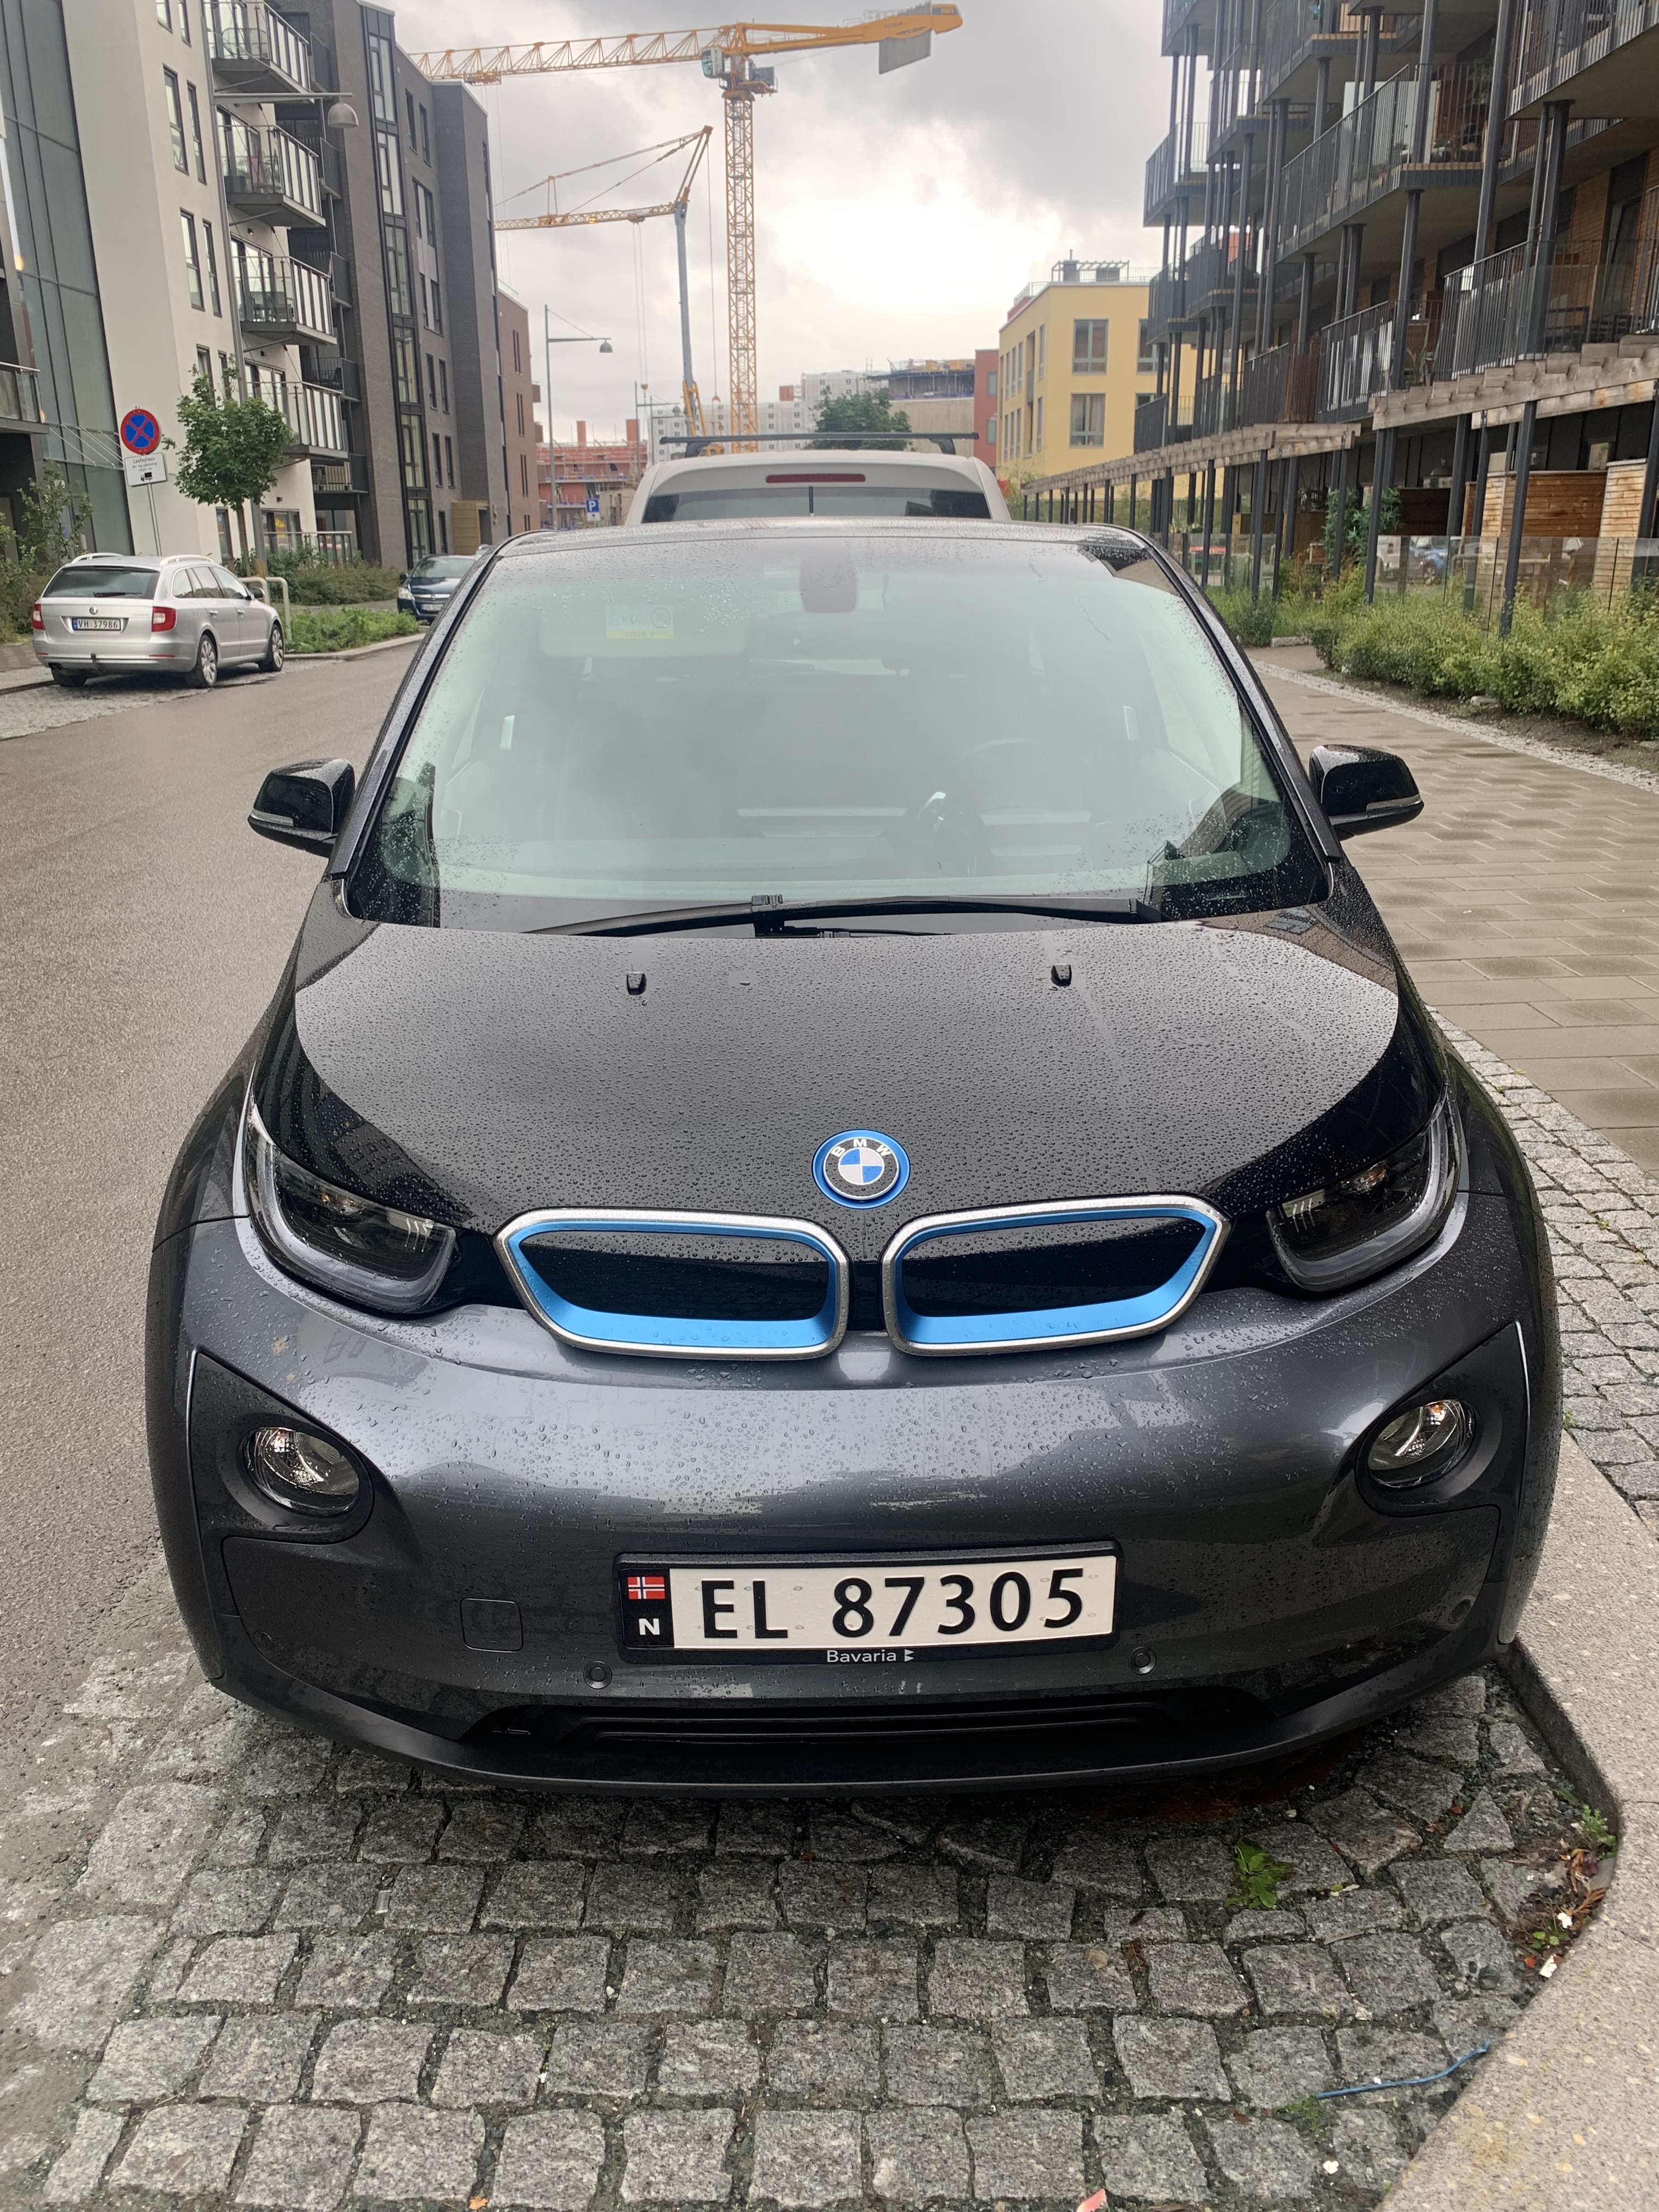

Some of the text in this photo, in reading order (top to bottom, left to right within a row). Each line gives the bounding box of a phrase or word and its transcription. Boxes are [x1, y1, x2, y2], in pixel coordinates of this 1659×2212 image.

[589, 501, 596, 511] P
[94, 620, 118, 628] 37986
[831, 1138, 891, 1158] BMW
[702, 1567, 1084, 1639] EL 87305
[639, 1618, 660, 1635] N
[827, 1649, 896, 1662] Bavaria
